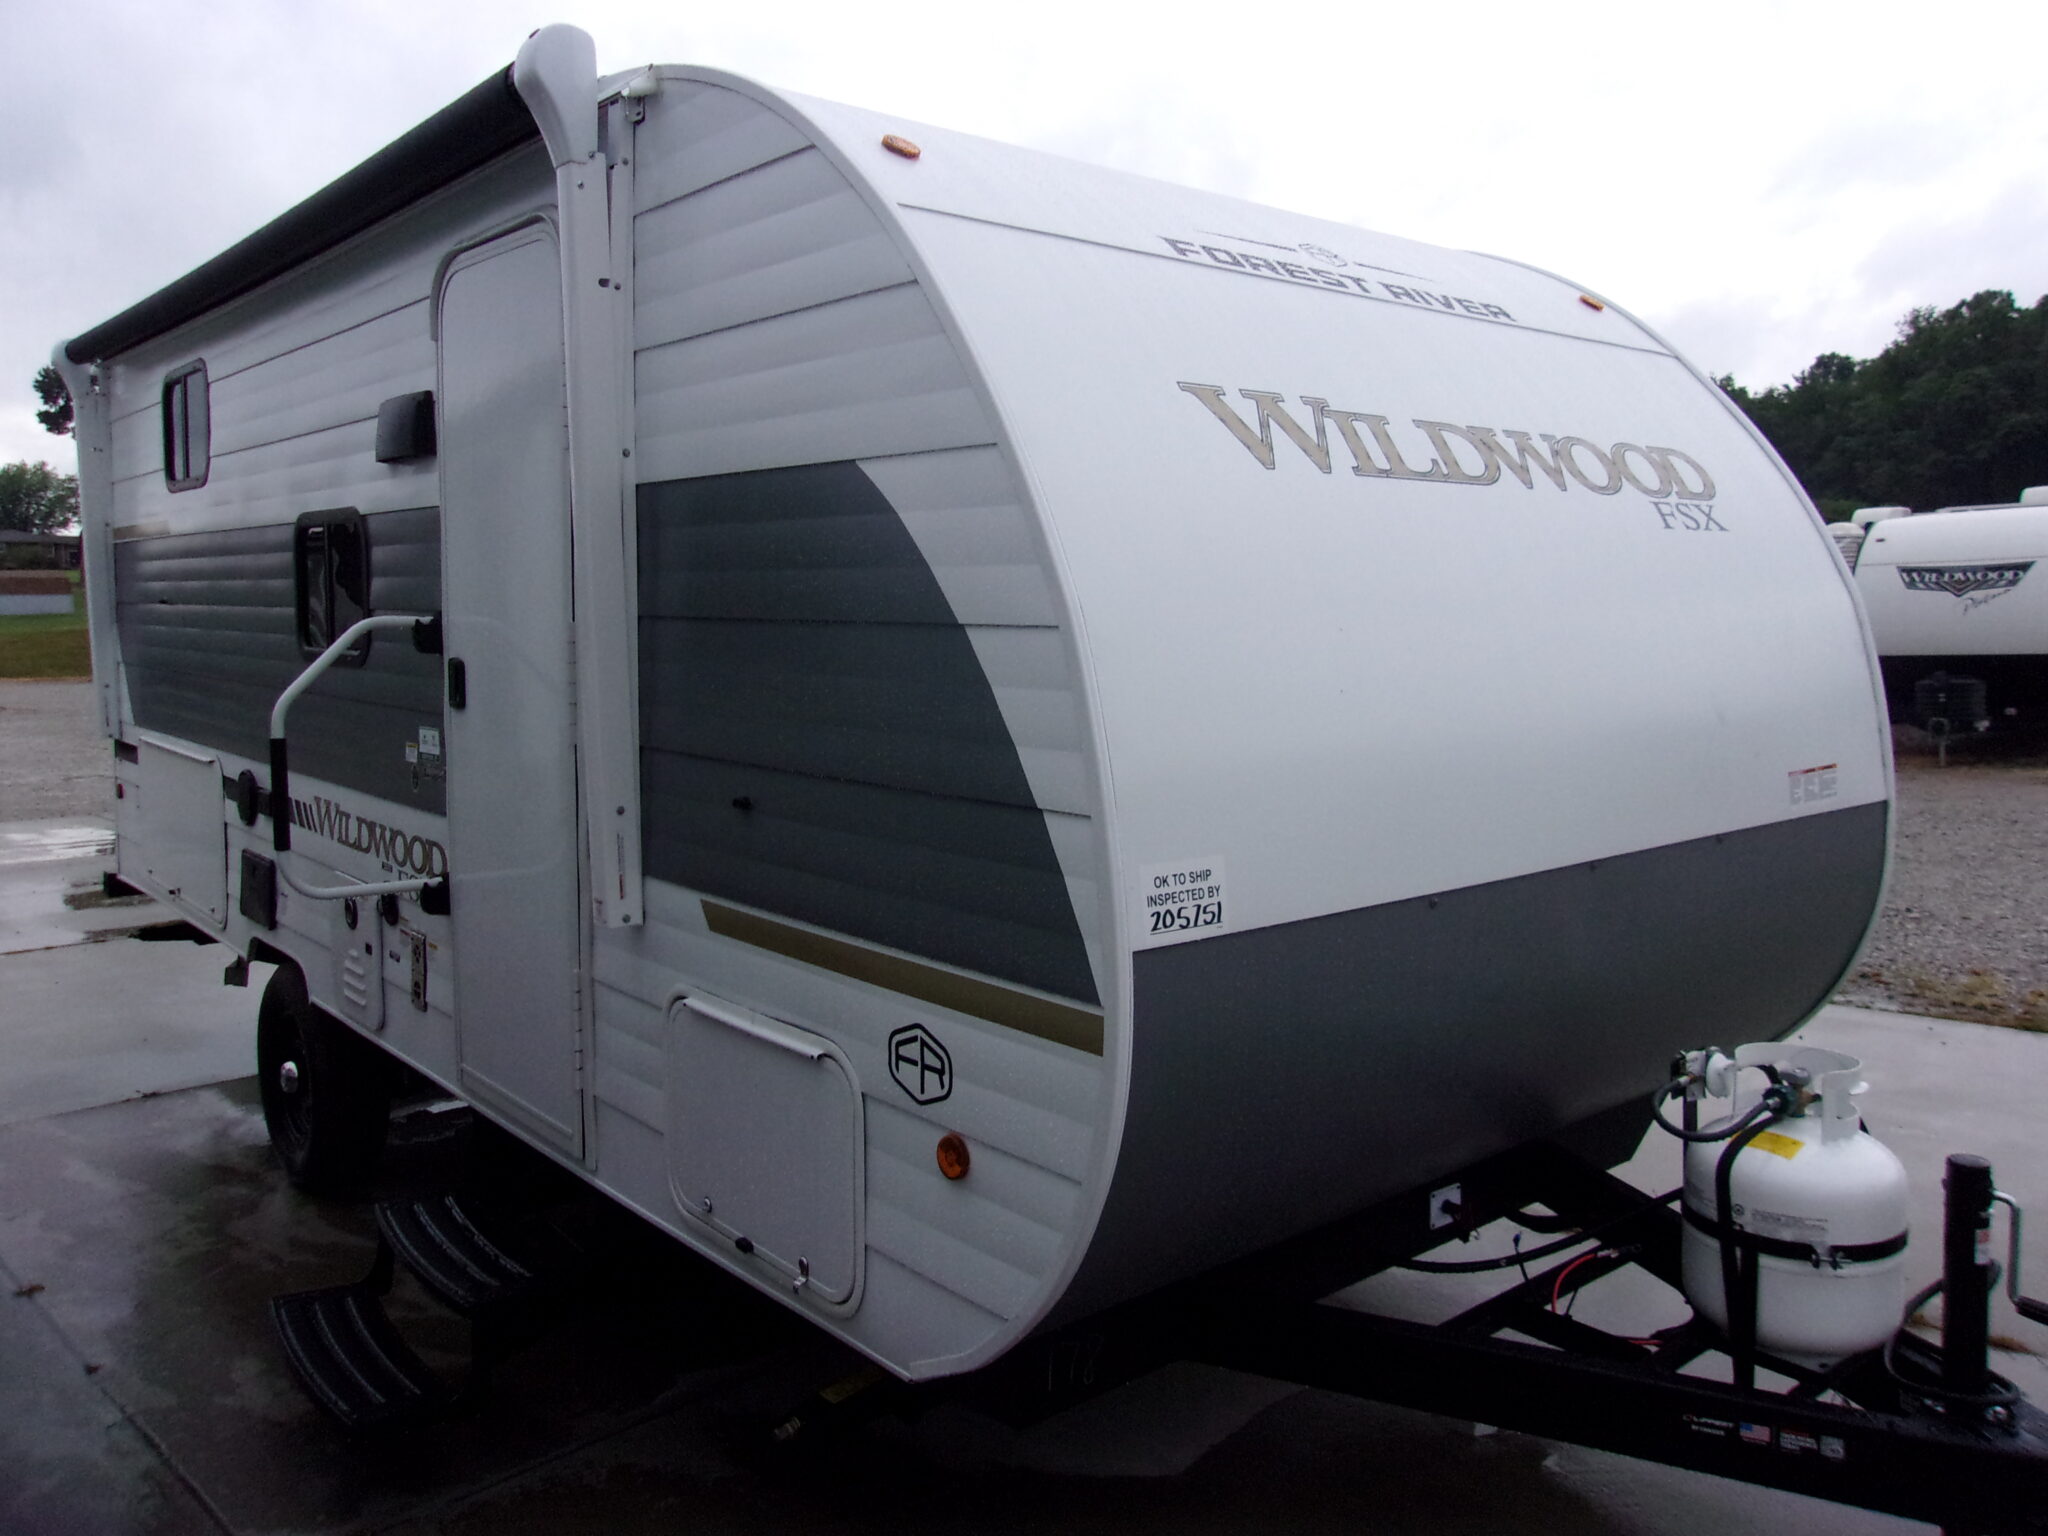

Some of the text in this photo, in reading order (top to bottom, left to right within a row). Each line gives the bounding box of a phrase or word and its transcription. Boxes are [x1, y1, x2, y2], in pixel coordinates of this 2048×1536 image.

[1158, 236, 1370, 294] FOREST
[1378, 282, 1516, 321] RIVER
[1177, 381, 1717, 501] WILDWOOD
[1649, 501, 1730, 532] FSX
[314, 796, 448, 877] WILDWOOD
[1153, 869, 1211, 888] OK TO SHIP
[1146, 885, 1220, 908] INSPECTED BY
[1150, 901, 1222, 932] 205751
